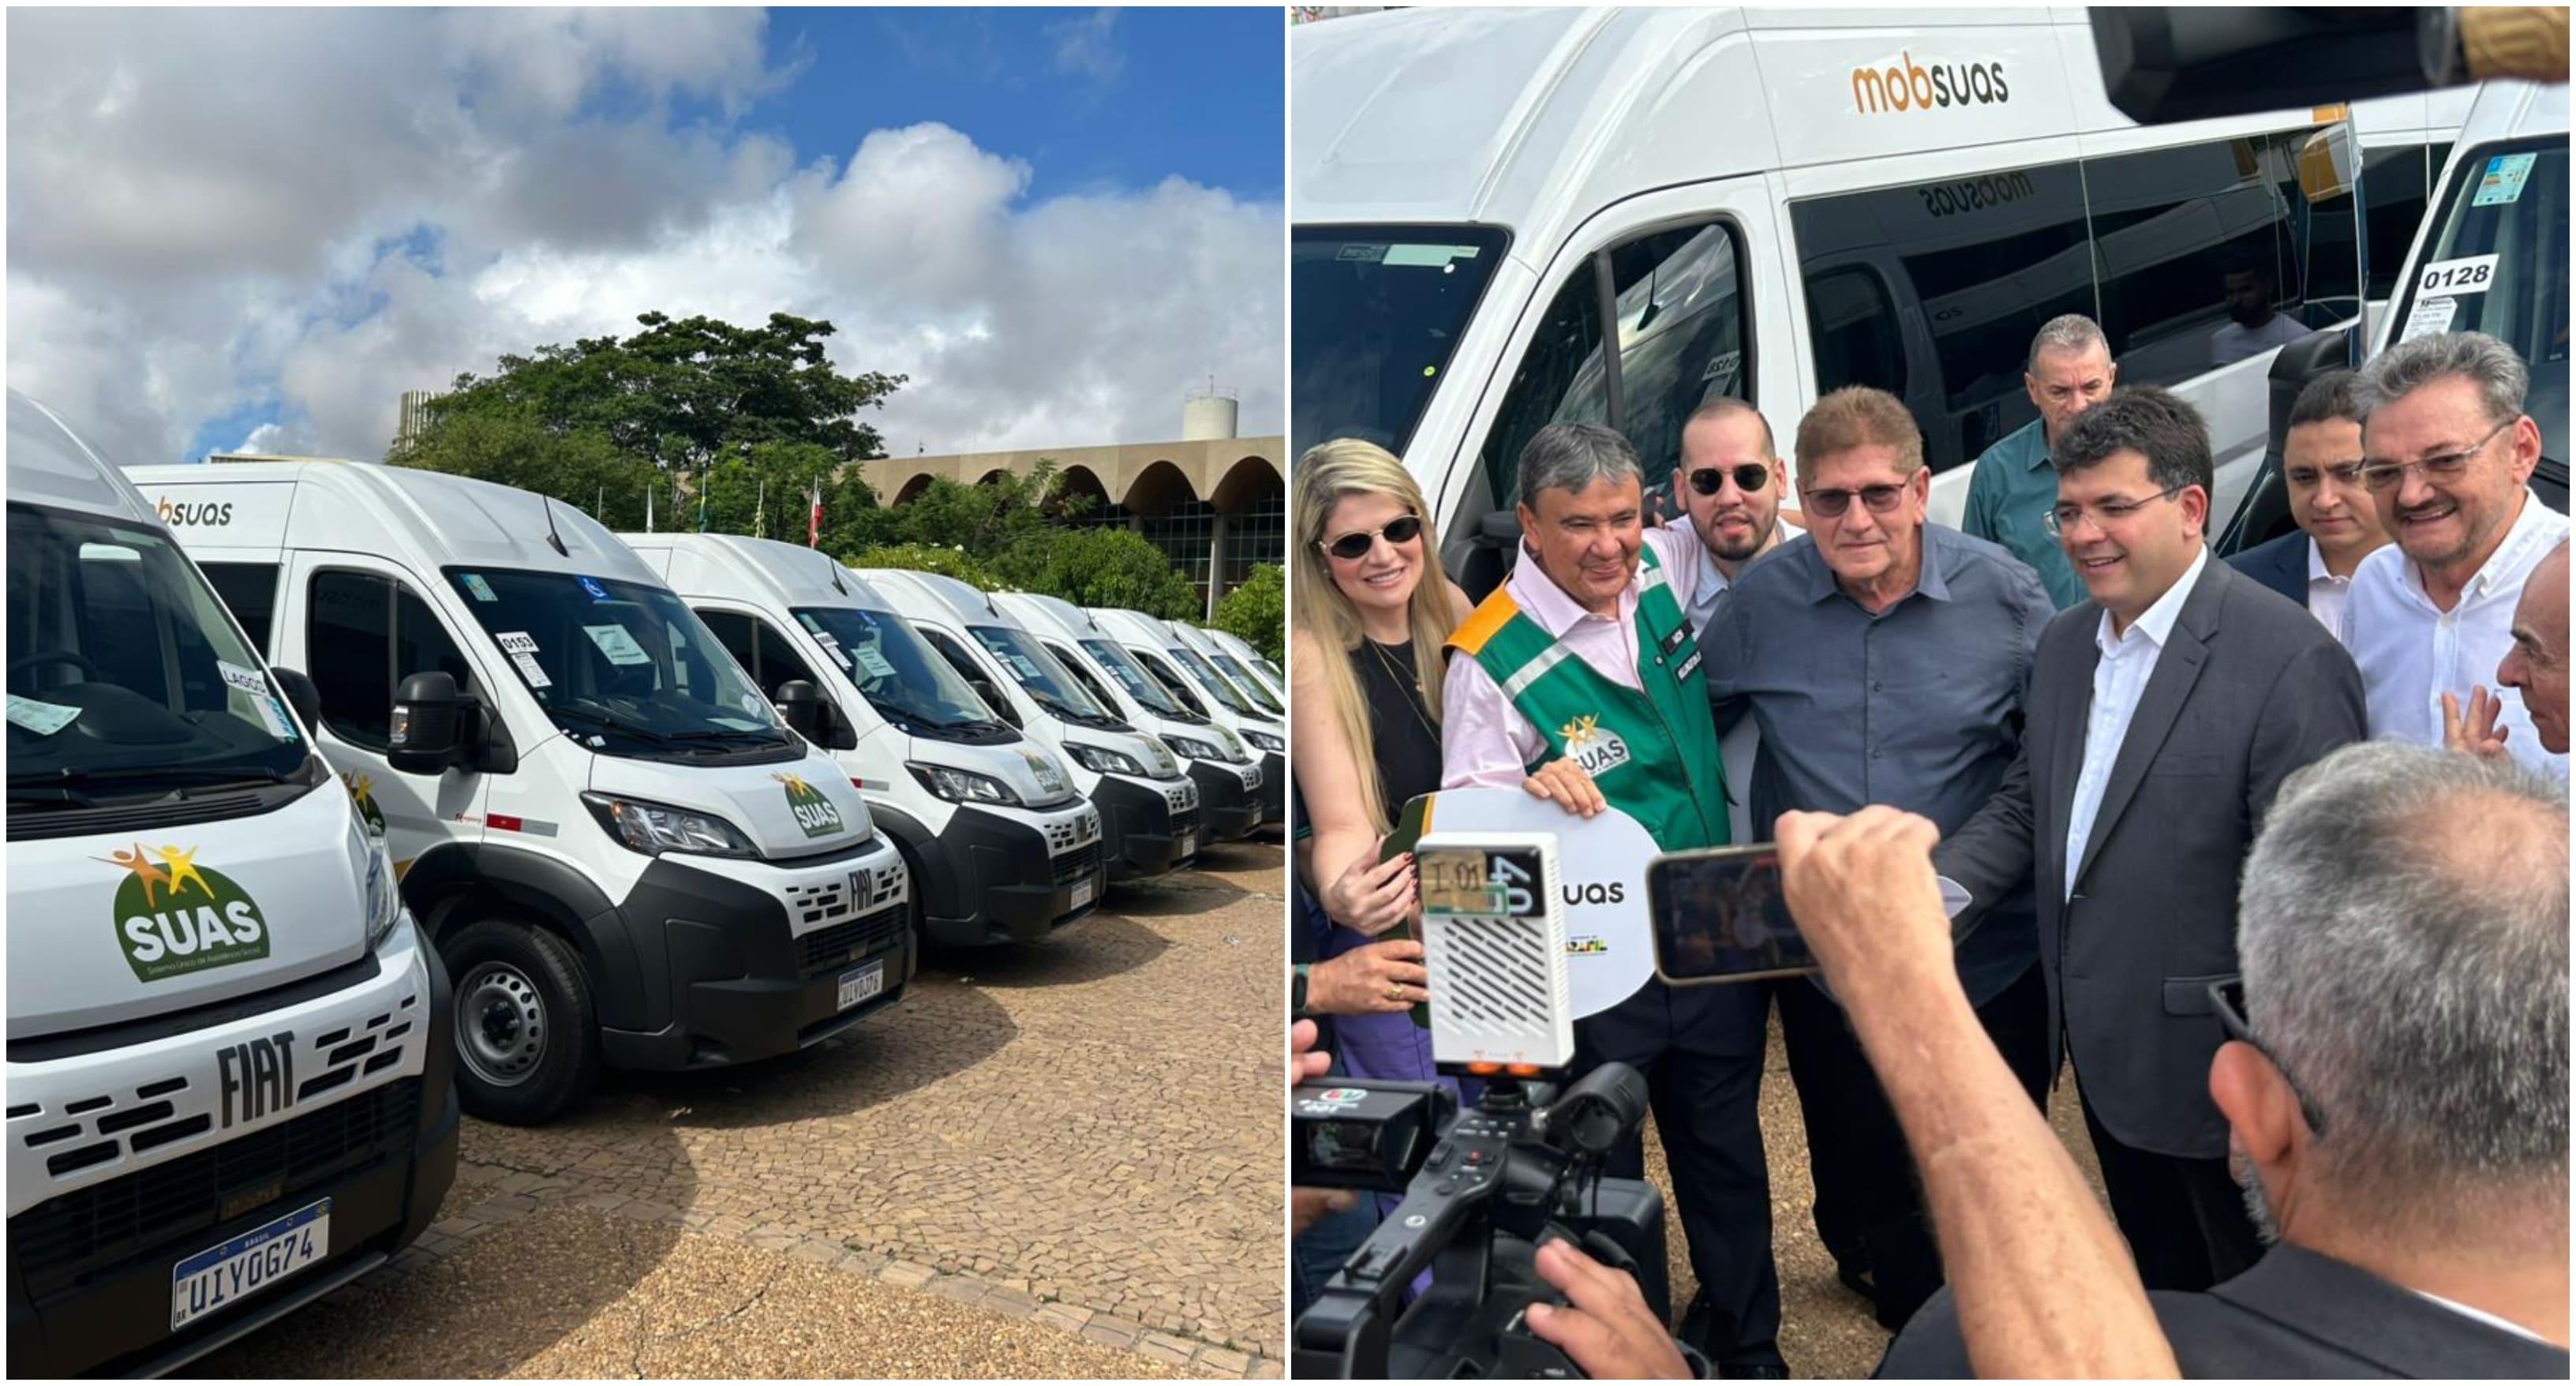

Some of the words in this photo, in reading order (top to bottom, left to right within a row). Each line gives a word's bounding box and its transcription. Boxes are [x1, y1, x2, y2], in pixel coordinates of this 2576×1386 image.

[1852, 51, 2009, 114] mobsuas
[2424, 264, 2490, 290] 0128
[157, 495, 233, 526] bsuas
[502, 636, 534, 649] 0153
[794, 801, 839, 829] SUAS
[848, 867, 872, 913] FIAT
[1563, 882, 1623, 905] uas
[125, 901, 261, 962] SUAS
[216, 1031, 296, 1129] FIAT
[244, 1233, 269, 1248] BRASIL
